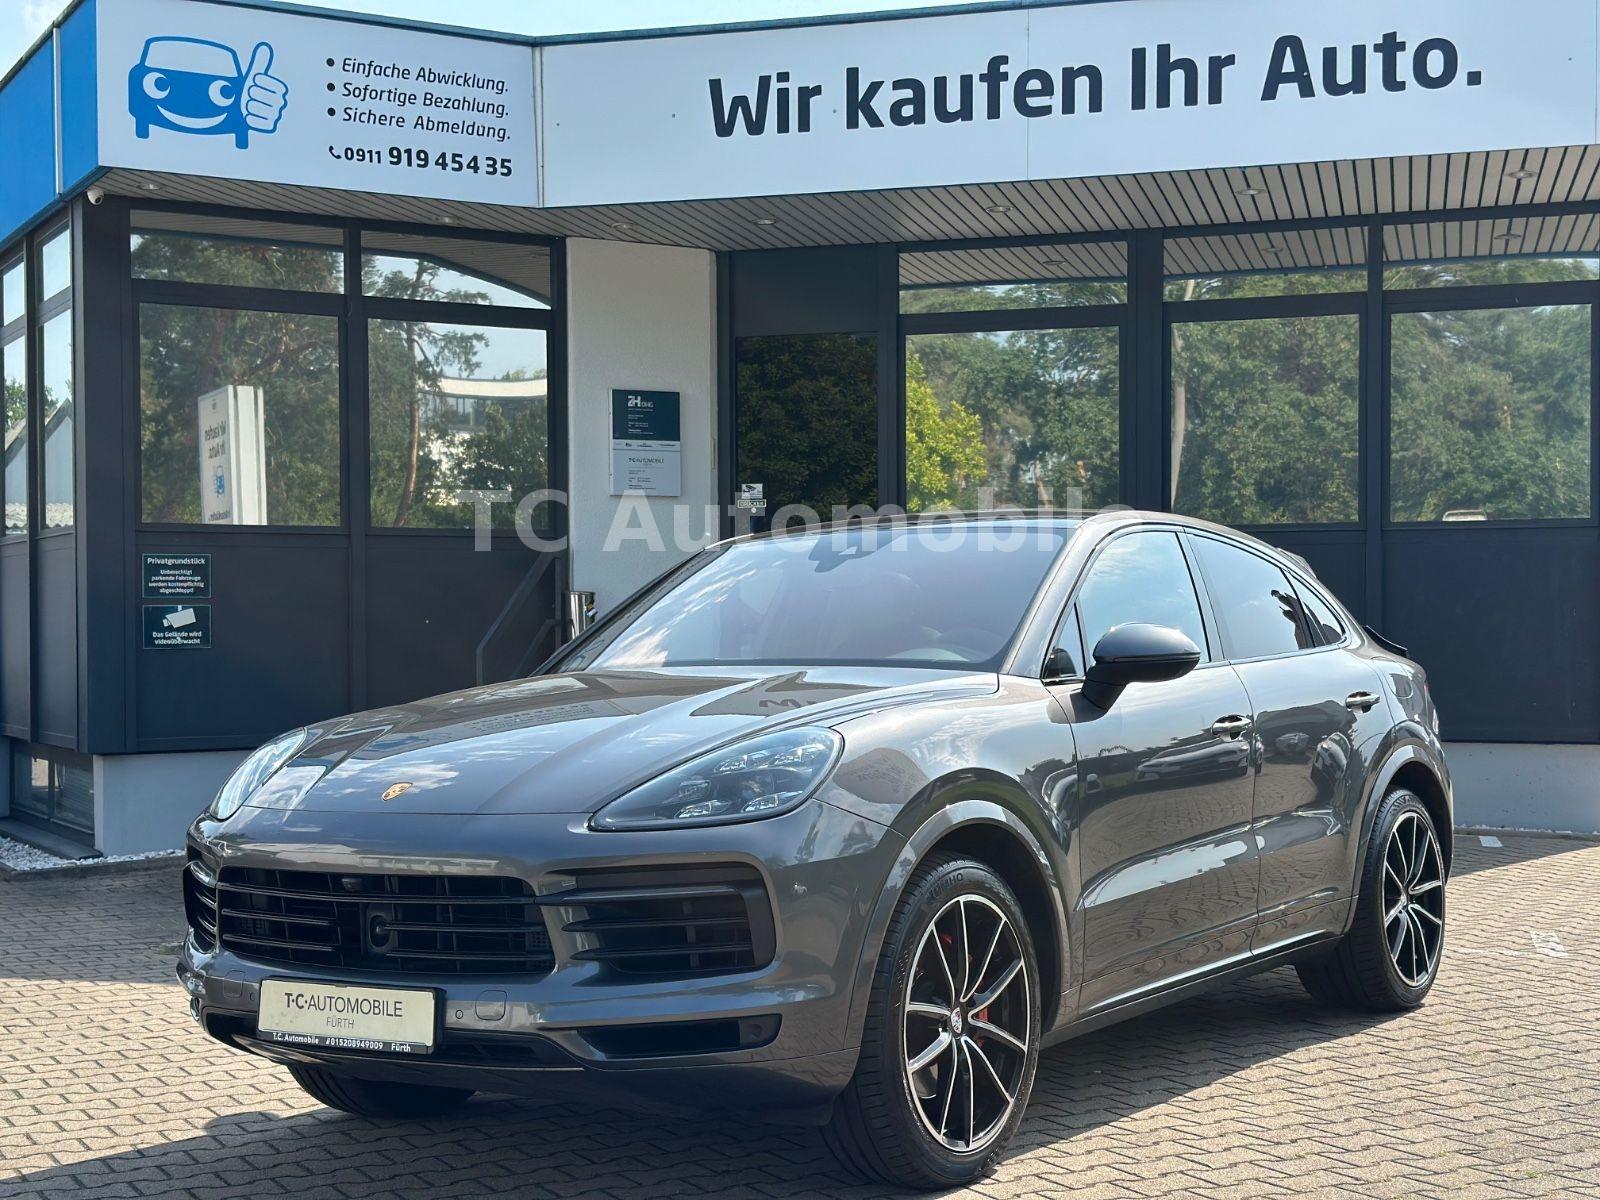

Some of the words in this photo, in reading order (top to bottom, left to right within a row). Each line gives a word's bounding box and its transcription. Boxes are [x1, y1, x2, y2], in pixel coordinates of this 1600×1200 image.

[342, 57, 411, 80] Einfache
[415, 67, 509, 95] Abwicklung.
[708, 71, 822, 137] Wir
[844, 54, 1102, 129] kaufen
[1131, 43, 1236, 110] Ihr
[1260, 31, 1482, 101] Auto.
[342, 82, 417, 107] Sofortige
[422, 92, 509, 118] Bezahlung.
[342, 107, 406, 128] Sichere
[413, 115, 511, 142] Abmeldung.
[344, 147, 381, 164] 0911
[388, 146, 429, 169] 919
[434, 152, 480, 174] 454
[485, 156, 512, 177] 35
[147, 557, 206, 566] Privatgrundstück
[326, 1016, 355, 1029] FÜRTH
[284, 1034, 319, 1045] Automobile
[391, 1042, 411, 1053] Fürth
